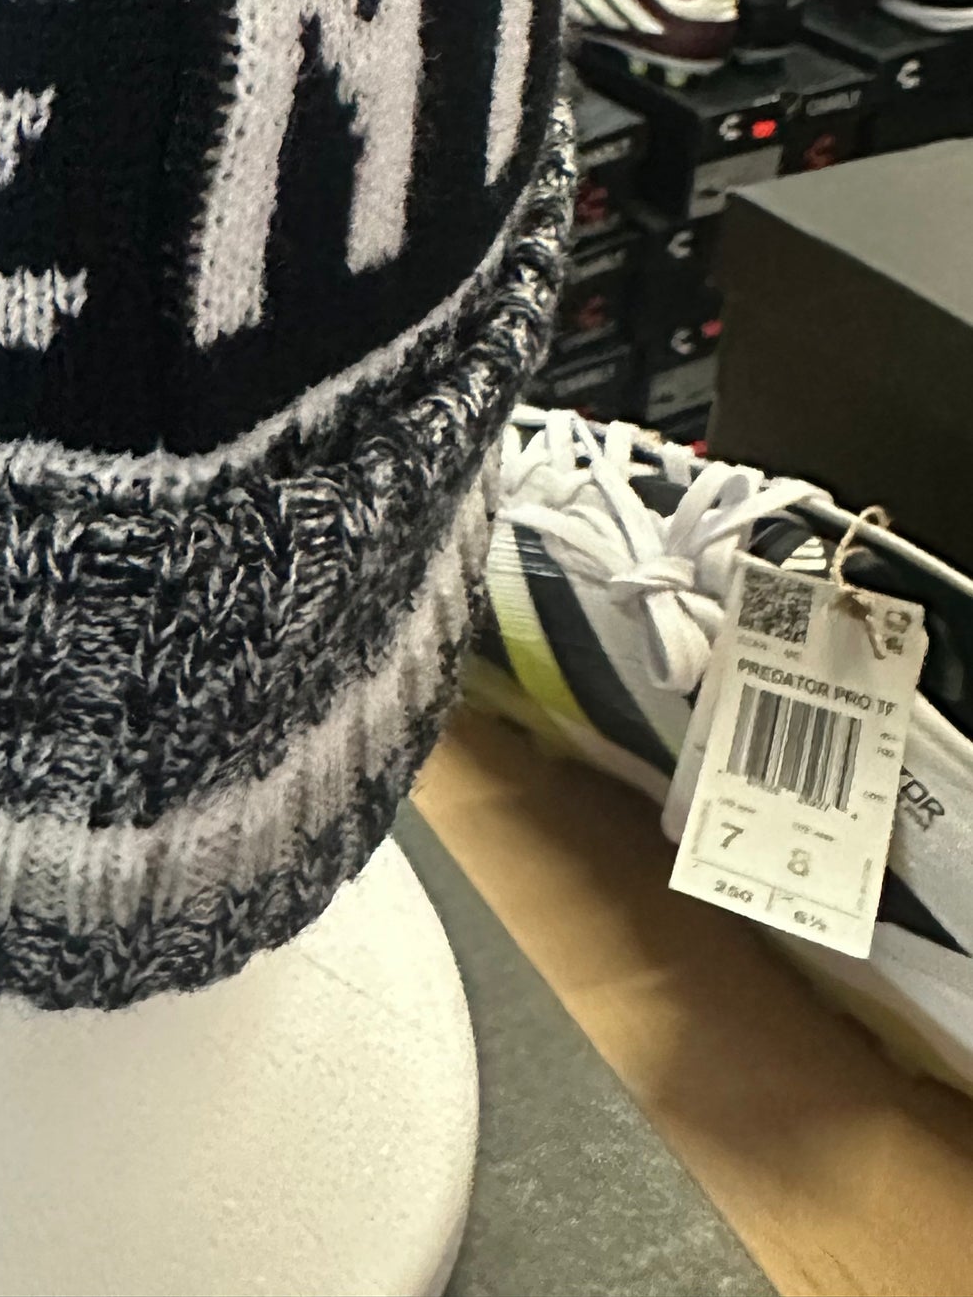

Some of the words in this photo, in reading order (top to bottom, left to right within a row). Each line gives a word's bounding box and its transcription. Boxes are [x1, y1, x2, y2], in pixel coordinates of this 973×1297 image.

[737, 658, 830, 696] PREDATOR
[835, 686, 871, 710] PRO
[721, 822, 744, 849] 7
[787, 848, 810, 876] 8
